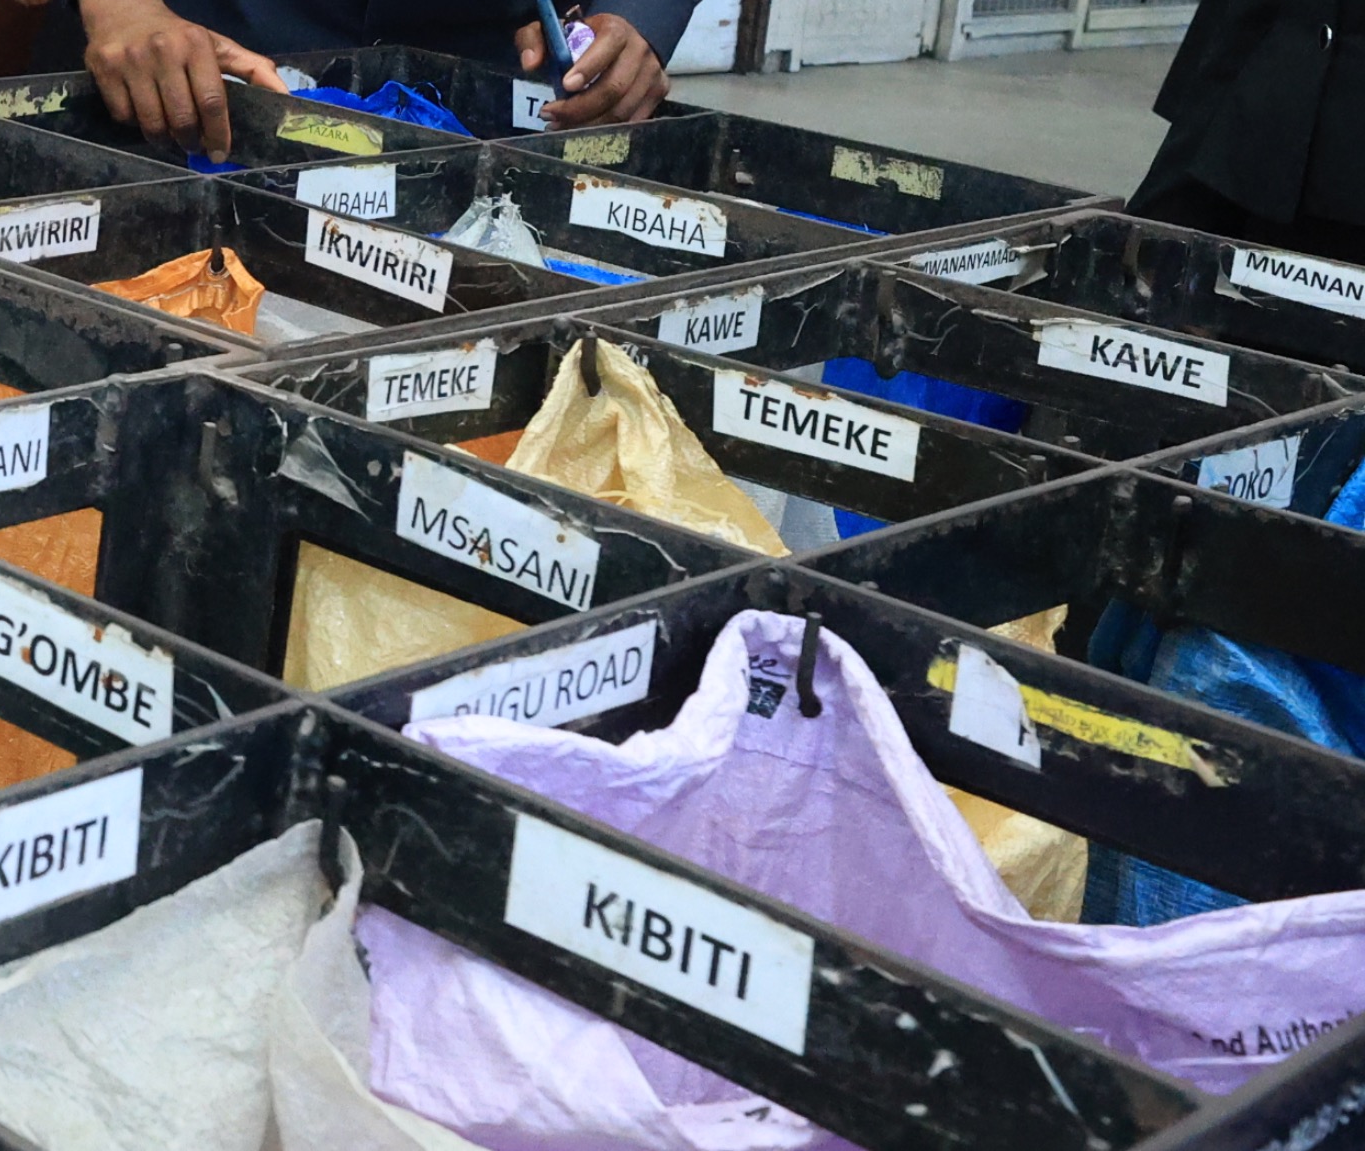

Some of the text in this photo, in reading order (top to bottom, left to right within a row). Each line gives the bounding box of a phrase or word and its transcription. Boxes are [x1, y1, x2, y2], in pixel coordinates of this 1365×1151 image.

[307, 124, 350, 143] TAZARA
[321, 190, 388, 215] KIBAHA
[606, 200, 706, 249] KIBAHA
[318, 223, 436, 295] IKWIRIRI
[684, 310, 746, 346] KAWE
[384, 365, 479, 405] TEMEKE
[1090, 334, 1205, 389] KAWE
[739, 388, 892, 461] TEMEKE
[410, 495, 594, 610] MSASANI
[555, 646, 643, 710] ROAD
[583, 882, 752, 1000] KIBITI
